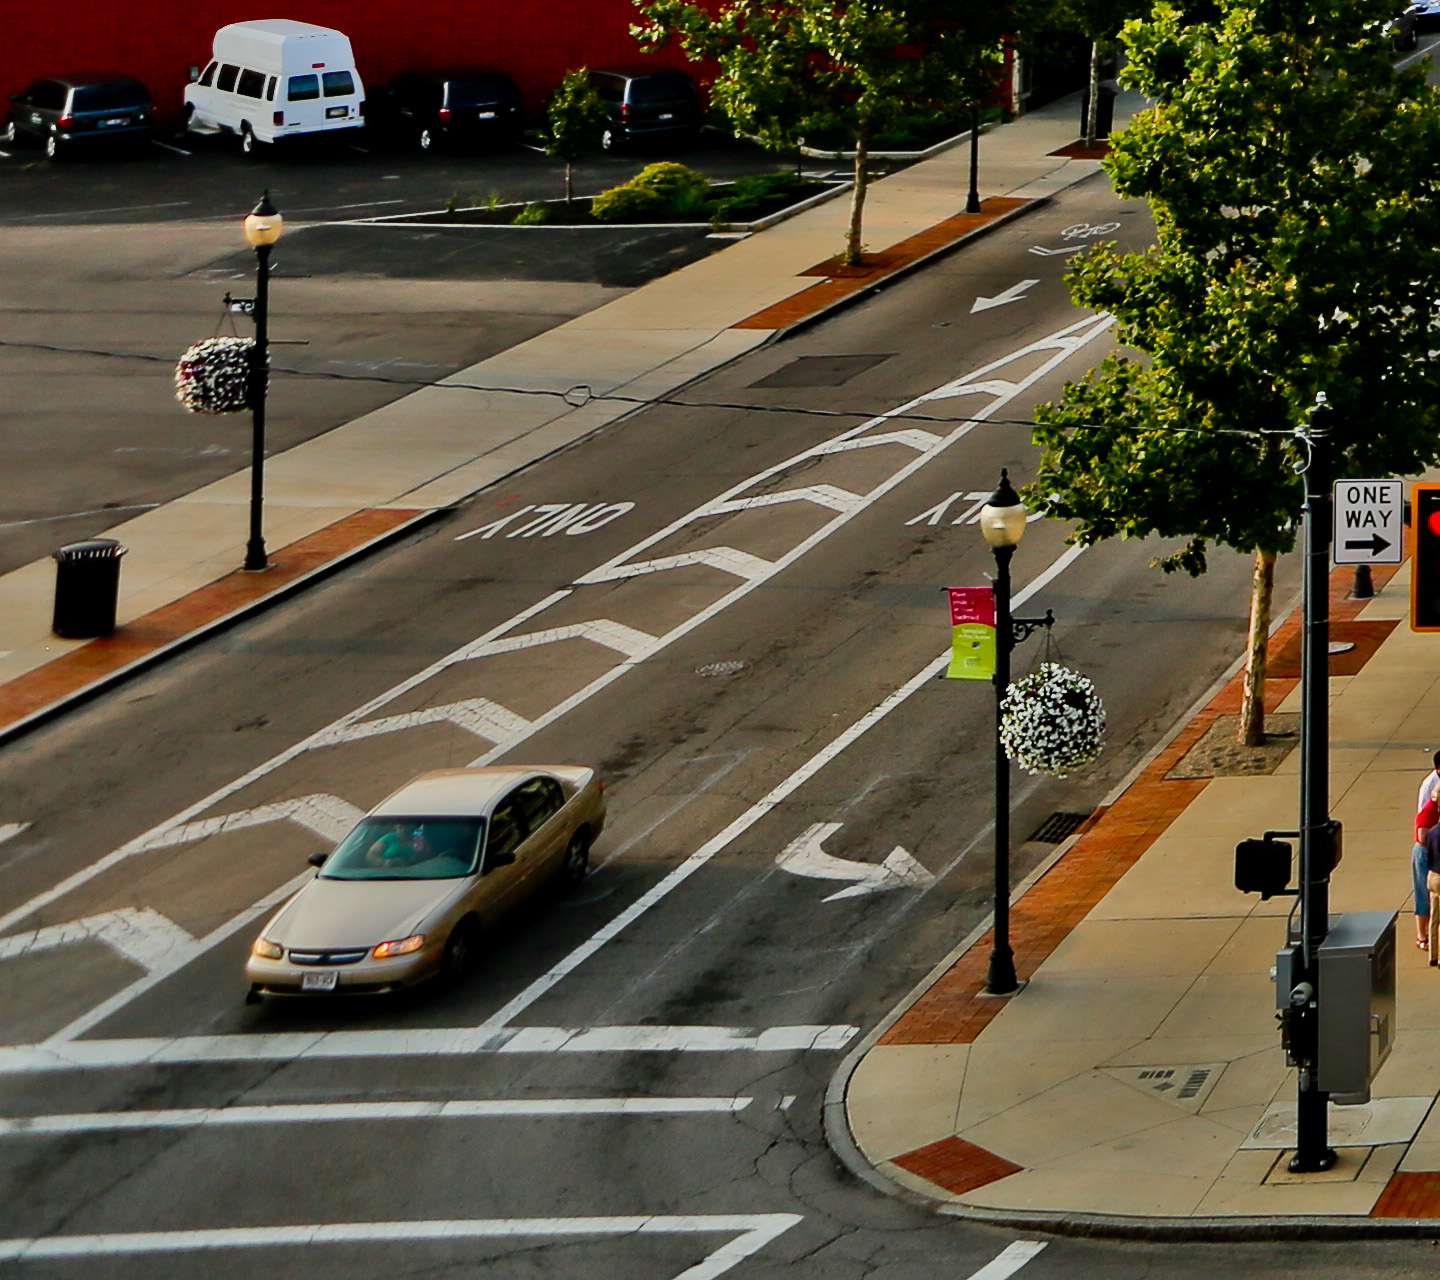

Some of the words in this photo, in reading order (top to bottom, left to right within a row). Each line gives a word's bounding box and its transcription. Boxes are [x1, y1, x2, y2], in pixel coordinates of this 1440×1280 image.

[1347, 486, 1392, 505] ONE
[453, 501, 636, 541] ONLY
[1345, 509, 1393, 529] WAY
